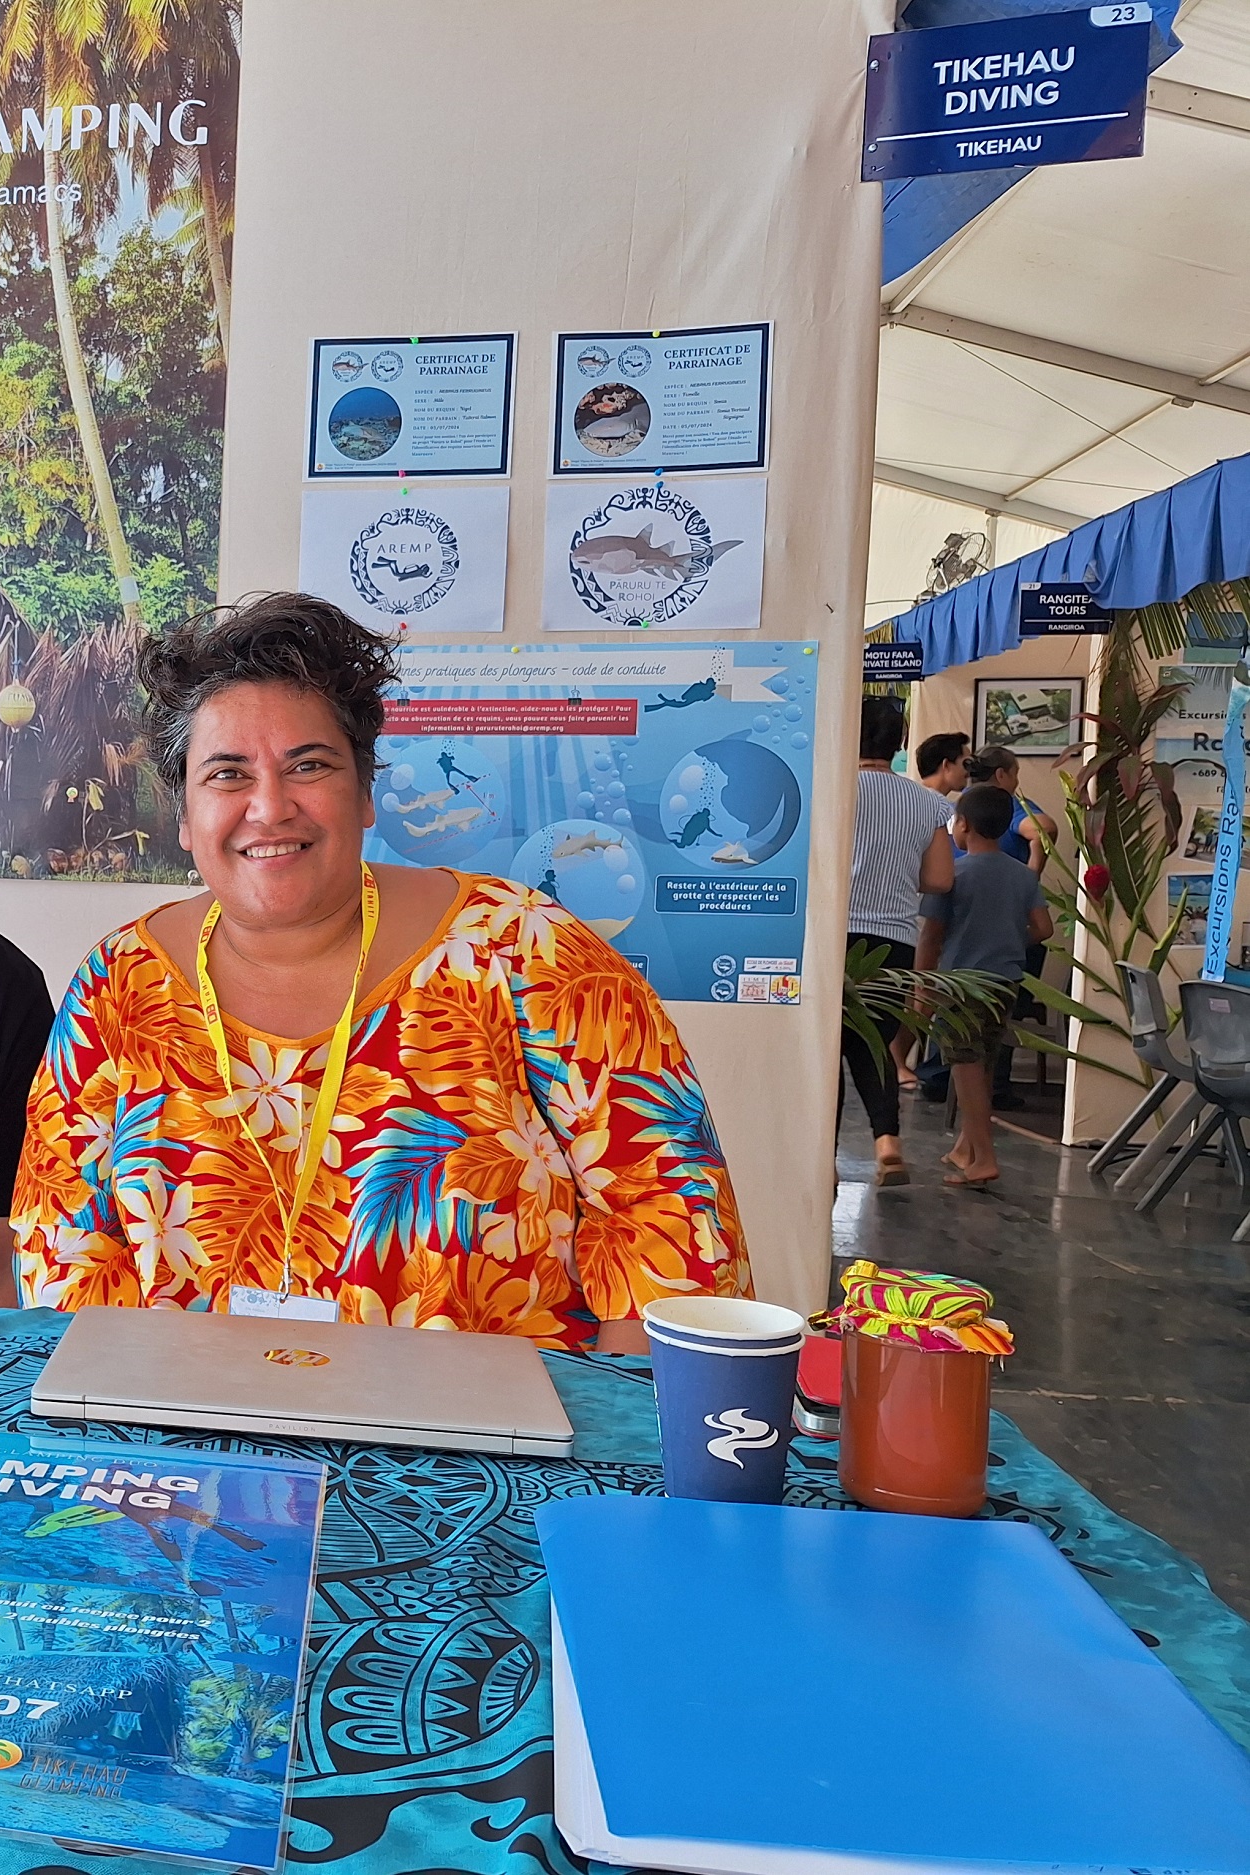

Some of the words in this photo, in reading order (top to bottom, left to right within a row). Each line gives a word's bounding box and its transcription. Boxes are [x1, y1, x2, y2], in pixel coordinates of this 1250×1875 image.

[1111, 6, 1135, 23] 23
[933, 46, 1075, 85] TIKEHAU
[944, 80, 1060, 116] DIVING
[956, 135, 1042, 158] TIKEHAU
[664, 346, 733, 359] CERTIFICAT
[735, 344, 751, 354] DE
[415, 354, 479, 365] CERTIFICAT
[481, 353, 496, 363] DE
[669, 357, 742, 370] PARRAINAGE
[419, 365, 489, 376] PARRAINAGE
[376, 543, 432, 554] AREMP
[656, 580, 667, 590] TE
[619, 592, 655, 601] ROHOI
[1049, 606, 1086, 615] TOURS
[865, 651, 890, 659] MOTU
[892, 651, 914, 659] FARA
[864, 660, 890, 668] RIVATE
[891, 659, 922, 667] ISLAND
[419, 664, 477, 682] pratiques
[480, 664, 497, 677] des
[495, 663, 557, 683] plongeurs
[572, 663, 597, 676] code
[600, 663, 613, 676] de
[617, 662, 667, 676] conduite
[433, 705, 469, 713] vulnérable
[578, 705, 608, 713] protégez
[568, 715, 584, 723] faire
[587, 715, 616, 723] parvenir
[667, 881, 696, 890] Rester
[700, 881, 705, 890] à
[709, 882, 759, 891] l'extérieur
[762, 883, 773, 891] de
[777, 883, 787, 891] la
[672, 892, 702, 901] grotte
[705, 892, 715, 900] et
[718, 892, 763, 902] respecter
[766, 893, 780, 901] les
[367, 890, 375, 918] TAHITI
[699, 901, 752, 911] procédures
[1207, 841, 1232, 976] Excursions
[264, 1349, 331, 1367] hp
[269, 1423, 316, 1432] PAVILION
[113, 1459, 159, 1468] DUO
[41, 1604, 66, 1612] en
[142, 1615, 194, 1626] pour
[195, 1619, 212, 1629] 2
[2, 1612, 18, 1620] 2
[19, 1613, 100, 1630] doubles
[103, 1623, 200, 1640] plongées
[30, 1754, 130, 1785] TIKEHAU
[20, 1773, 122, 1799] GLAMPING
